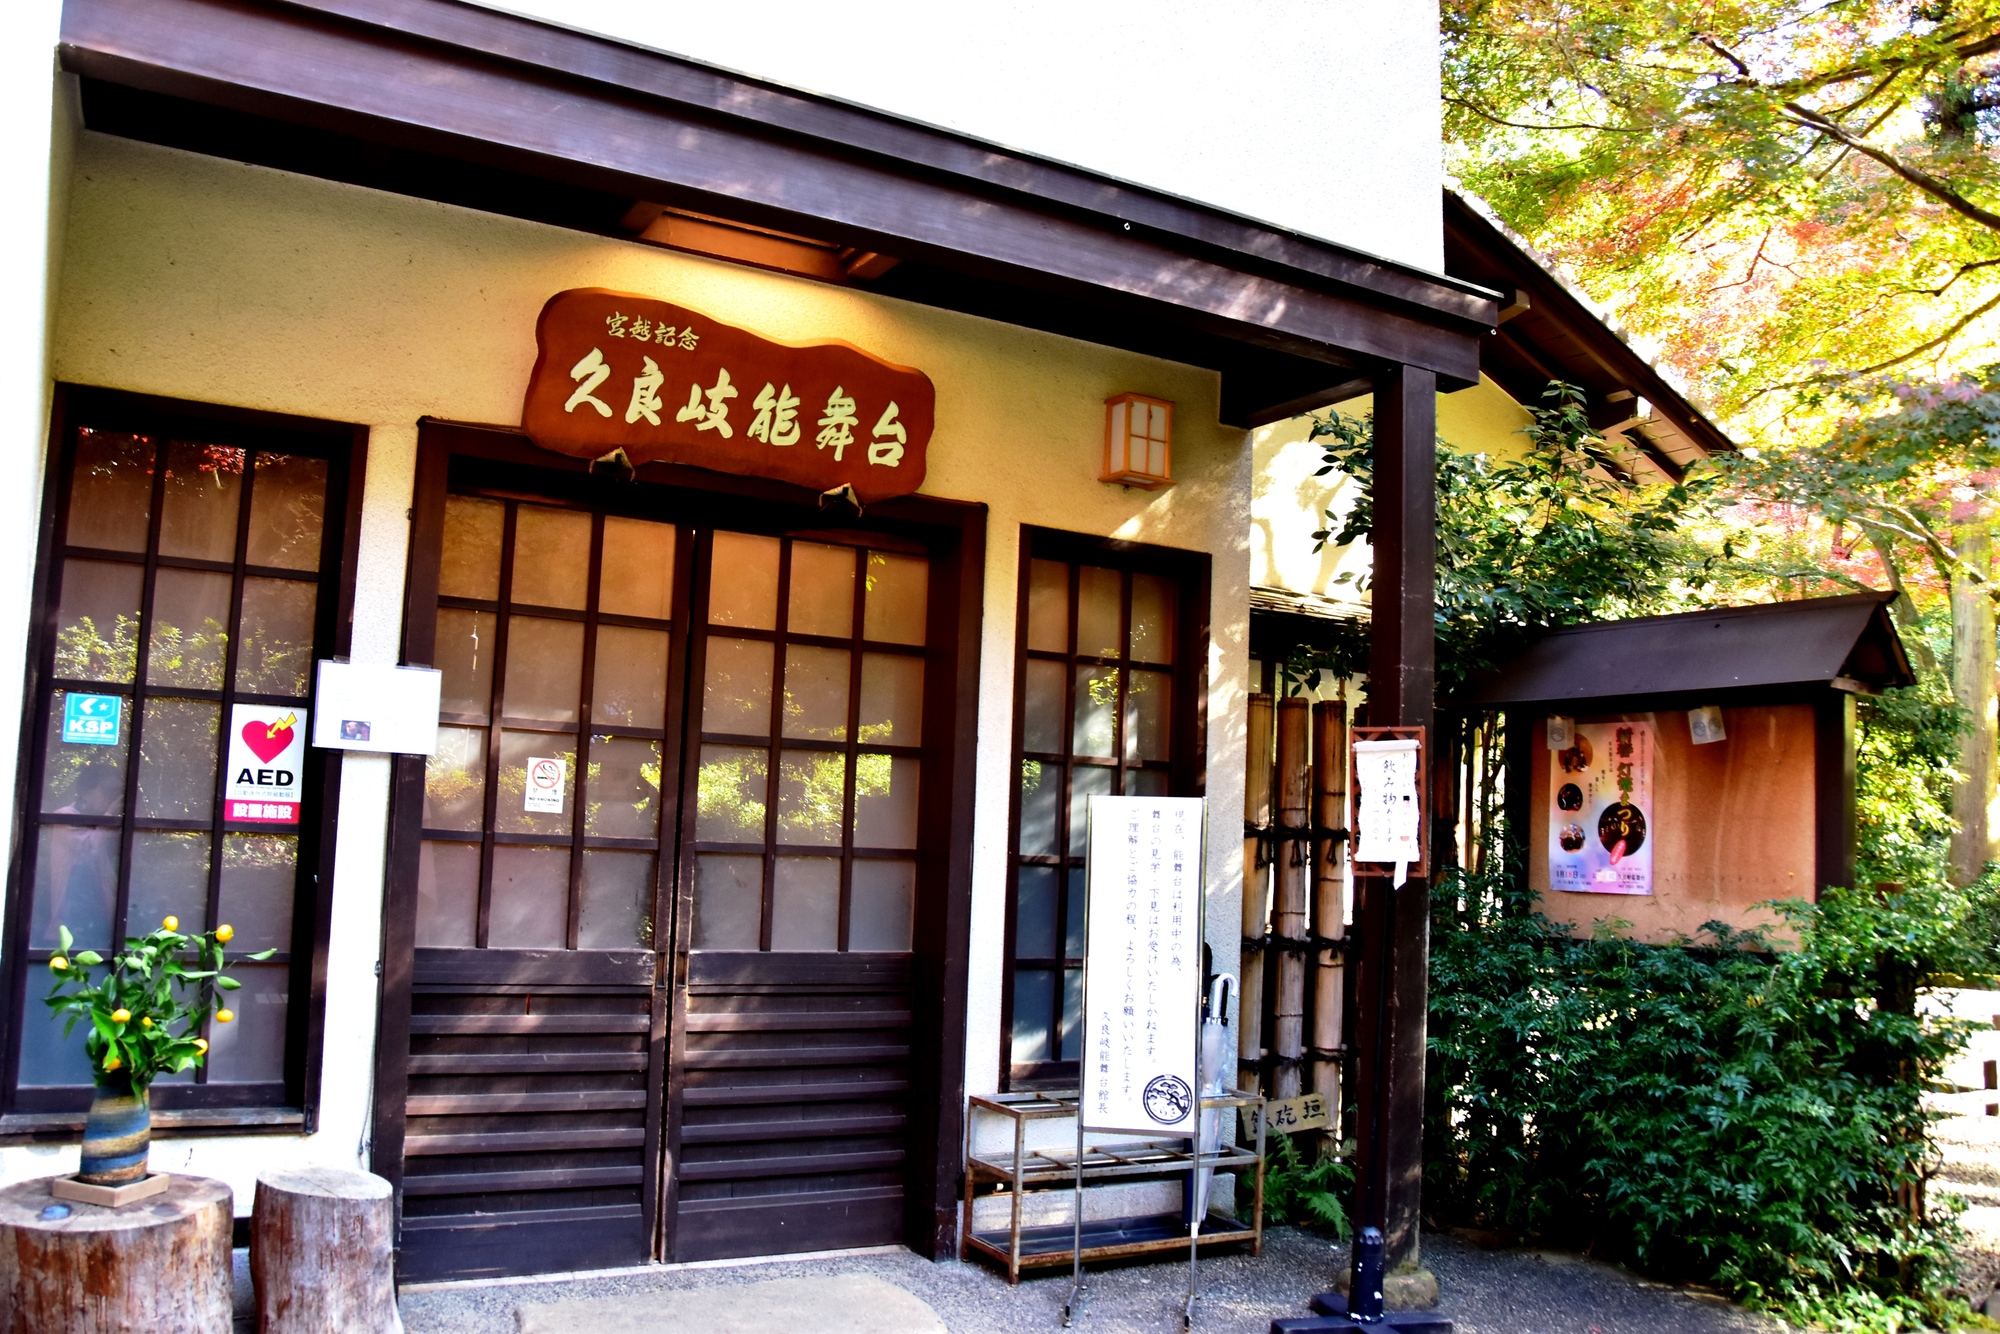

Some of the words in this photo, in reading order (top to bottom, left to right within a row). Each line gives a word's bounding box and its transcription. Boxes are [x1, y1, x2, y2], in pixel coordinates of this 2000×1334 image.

[606, 311, 699, 351] 宮越記念
[564, 347, 907, 468] 久良岐能舞台
[69, 719, 114, 735] KSP
[236, 768, 294, 787] AED
[233, 803, 293, 819] 設置施設
